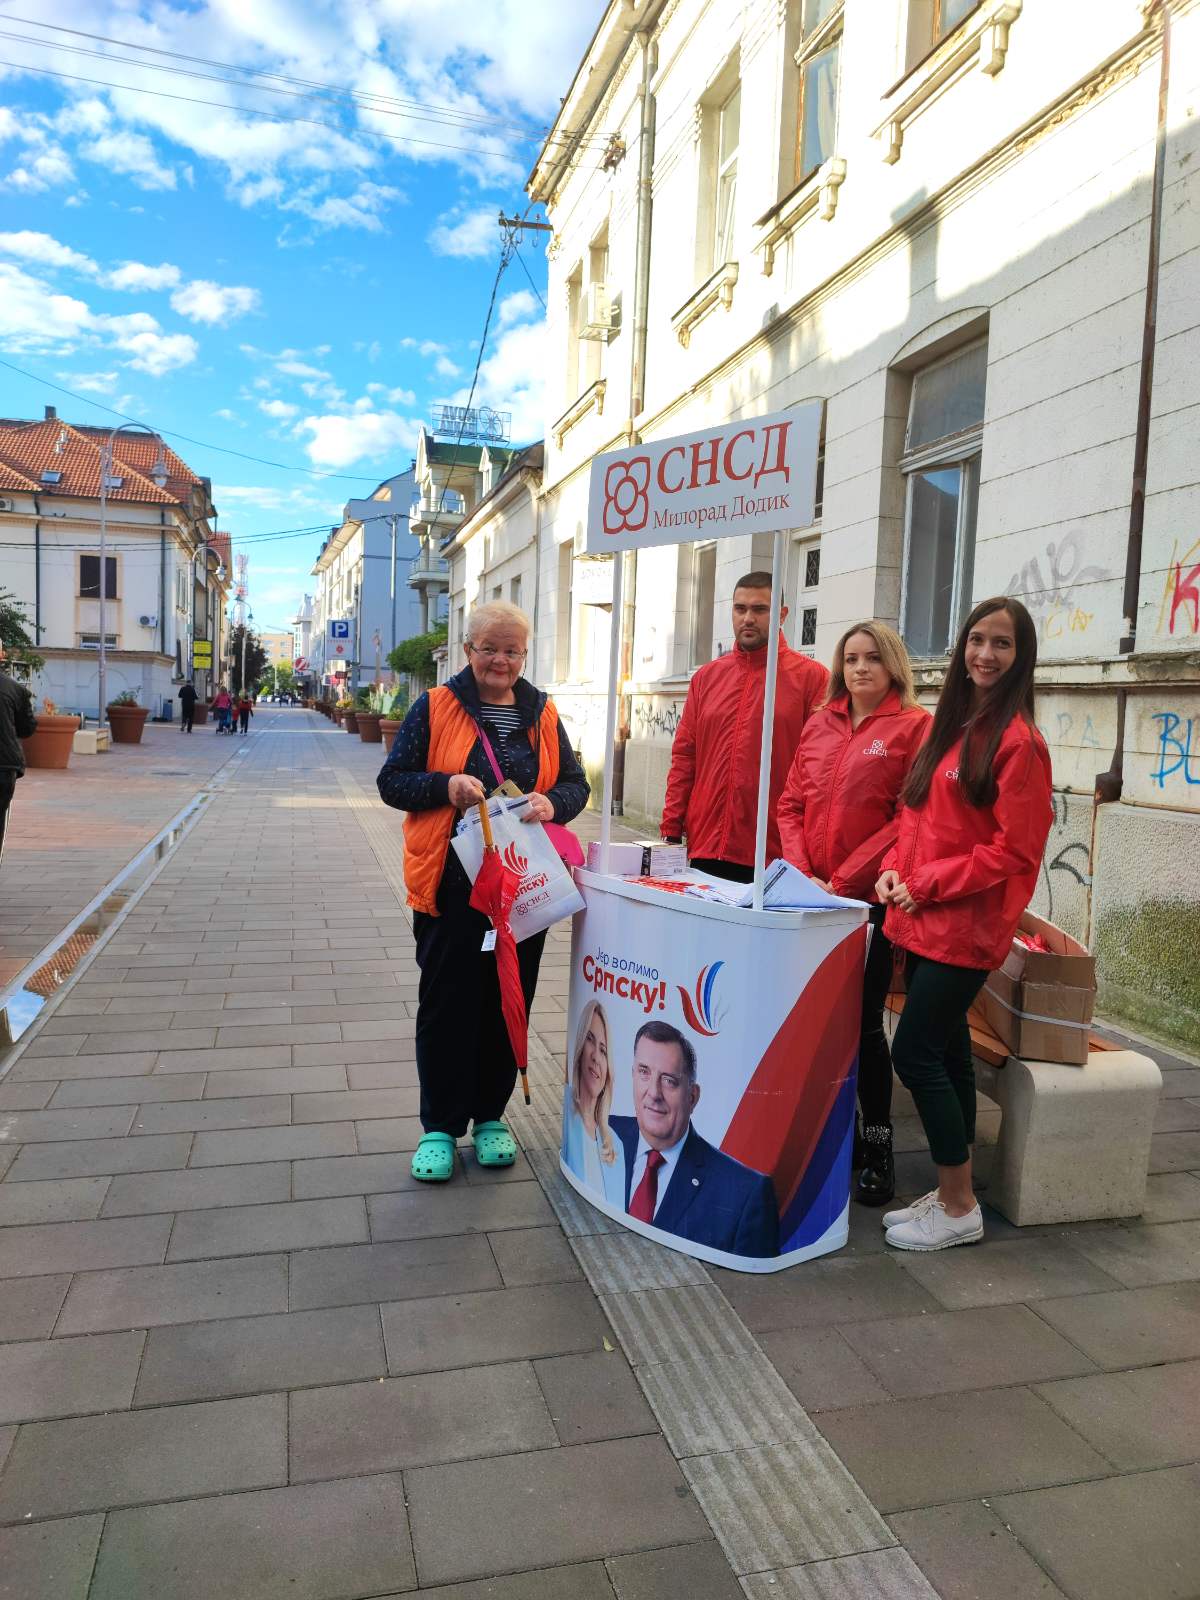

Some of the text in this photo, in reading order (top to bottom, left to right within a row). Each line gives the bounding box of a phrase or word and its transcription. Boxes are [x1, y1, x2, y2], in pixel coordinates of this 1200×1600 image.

[657, 421, 793, 493] СНСД
[653, 493, 790, 530] Милорад Додик
[335, 622, 347, 638] P
[582, 954, 667, 1014] Српску!
[611, 956, 659, 981] волимо
